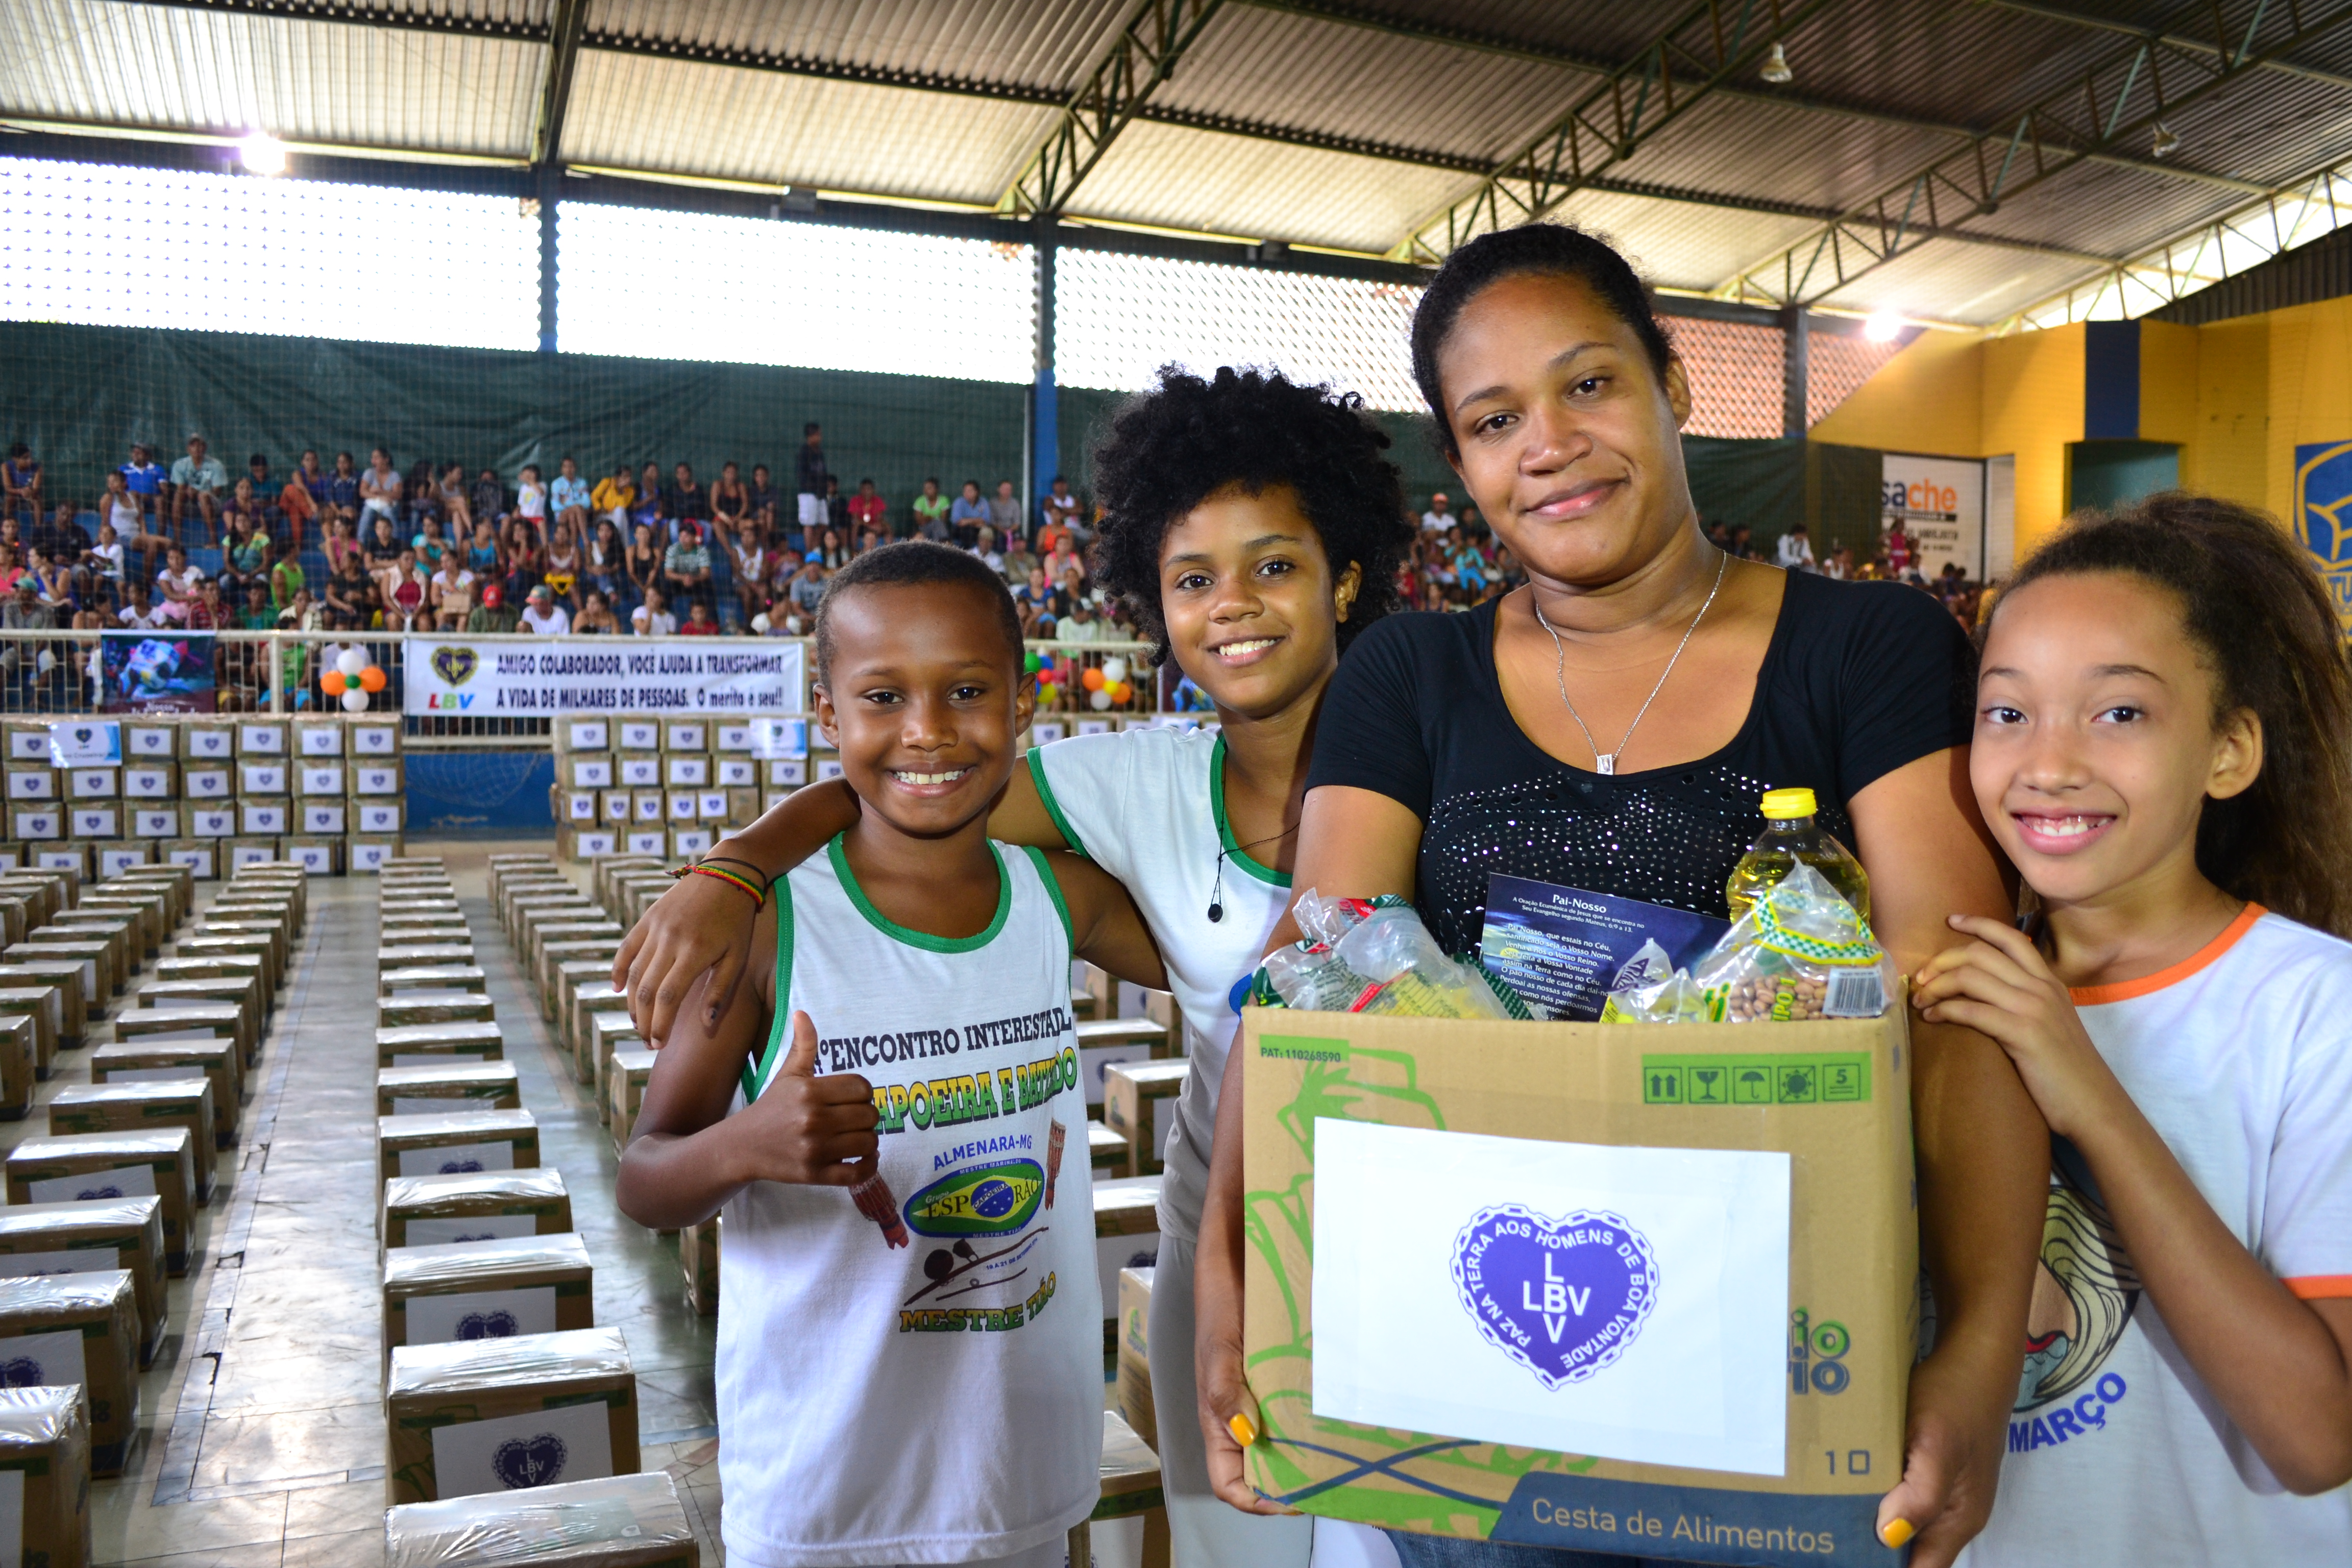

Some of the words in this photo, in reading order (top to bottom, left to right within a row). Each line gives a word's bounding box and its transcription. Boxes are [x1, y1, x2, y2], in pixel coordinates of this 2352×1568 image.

[497, 654, 535, 675] AMIGO
[541, 654, 624, 679] COLABORADOR,
[628, 648, 654, 674] VOCÊ
[658, 654, 692, 674] AJUDA
[696, 654, 703, 674] A
[707, 654, 782, 674] TRANSFORMAR
[428, 693, 475, 710] LBV
[496, 688, 504, 708] A
[509, 688, 536, 708] VIDA
[542, 688, 554, 708] DE
[560, 688, 616, 708] MILHARES
[620, 688, 634, 707] DE
[639, 688, 689, 708] PESSOAS.
[697, 687, 704, 707] O
[709, 685, 744, 707] mérito
[758, 686, 782, 707] seu!!
[1518, 897, 1537, 906] Oração
[1539, 901, 1567, 913] Ecumênica
[1577, 909, 1591, 918] Jesus
[1611, 917, 1636, 927] encontra
[1533, 907, 1560, 919] Evangelho
[1561, 913, 1584, 923] segundo
[1553, 894, 1607, 914] Pai-Nosso
[1507, 933, 1544, 946] santificado
[1546, 941, 1559, 949] seja
[1569, 945, 1589, 956] Vosso
[1591, 951, 1615, 962] Nome.
[1520, 925, 1544, 937] Nosso,
[1547, 933, 1559, 941] que
[1561, 936, 1582, 945] estais
[1504, 949, 1518, 959] Seja
[1520, 953, 1535, 962] feita
[1544, 958, 1563, 968] Vossa
[1564, 963, 1594, 975] Vontade
[1505, 941, 1526, 950] Venha
[1534, 947, 1547, 955] nós
[1555, 951, 1576, 961] Vosso
[1577, 956, 1599, 967] Reino.
[1502, 959, 1523, 968] assim
[1535, 965, 1551, 974] Terra
[1553, 970, 1573, 979] como
[1524, 972, 1545, 982] nosso
[1546, 976, 1555, 985] de
[1556, 980, 1573, 990] cada
[1500, 974, 1526, 987] Perdoai
[1536, 985, 1560, 995] nossas
[1562, 990, 1591, 1002] ofensas,
[1519, 989, 1539, 999] como
[1540, 993, 1554, 1002] nós
[1555, 997, 1598, 1014] perdoarmos
[1260, 1047, 1283, 1059] PAT:
[1286, 1048, 1341, 1063] 110268590
[1836, 1068, 1847, 1084] 5
[872, 1071, 998, 1135] APOEIRA
[997, 1067, 1016, 1116] E
[934, 1134, 1032, 1171] ALMENARA-MG
[960, 1164, 987, 1174] MESTRE
[925, 1191, 949, 1204] Grupo
[927, 1194, 969, 1220] ESP
[973, 1183, 1009, 1209] CAPOEIRA
[1496, 1220, 1531, 1239] AOS
[1536, 1229, 1613, 1250] HOMENS
[1466, 1233, 1493, 1293] TERRA
[1616, 1242, 1640, 1269] DE
[1523, 1280, 1590, 1316] LBV
[1623, 1273, 1645, 1312] BOA
[900, 1304, 1024, 1332] MESTRE
[1481, 1293, 1502, 1319] NA
[1499, 1317, 1531, 1348] PAZ
[1560, 1314, 1630, 1369] VONTADE
[2008, 1371, 2127, 1453] MARÇO
[520, 1460, 544, 1475] LBV
[1533, 1498, 1617, 1533] Cesta
[1627, 1507, 1663, 1537] de
[1672, 1515, 1835, 1555] Alimentos
